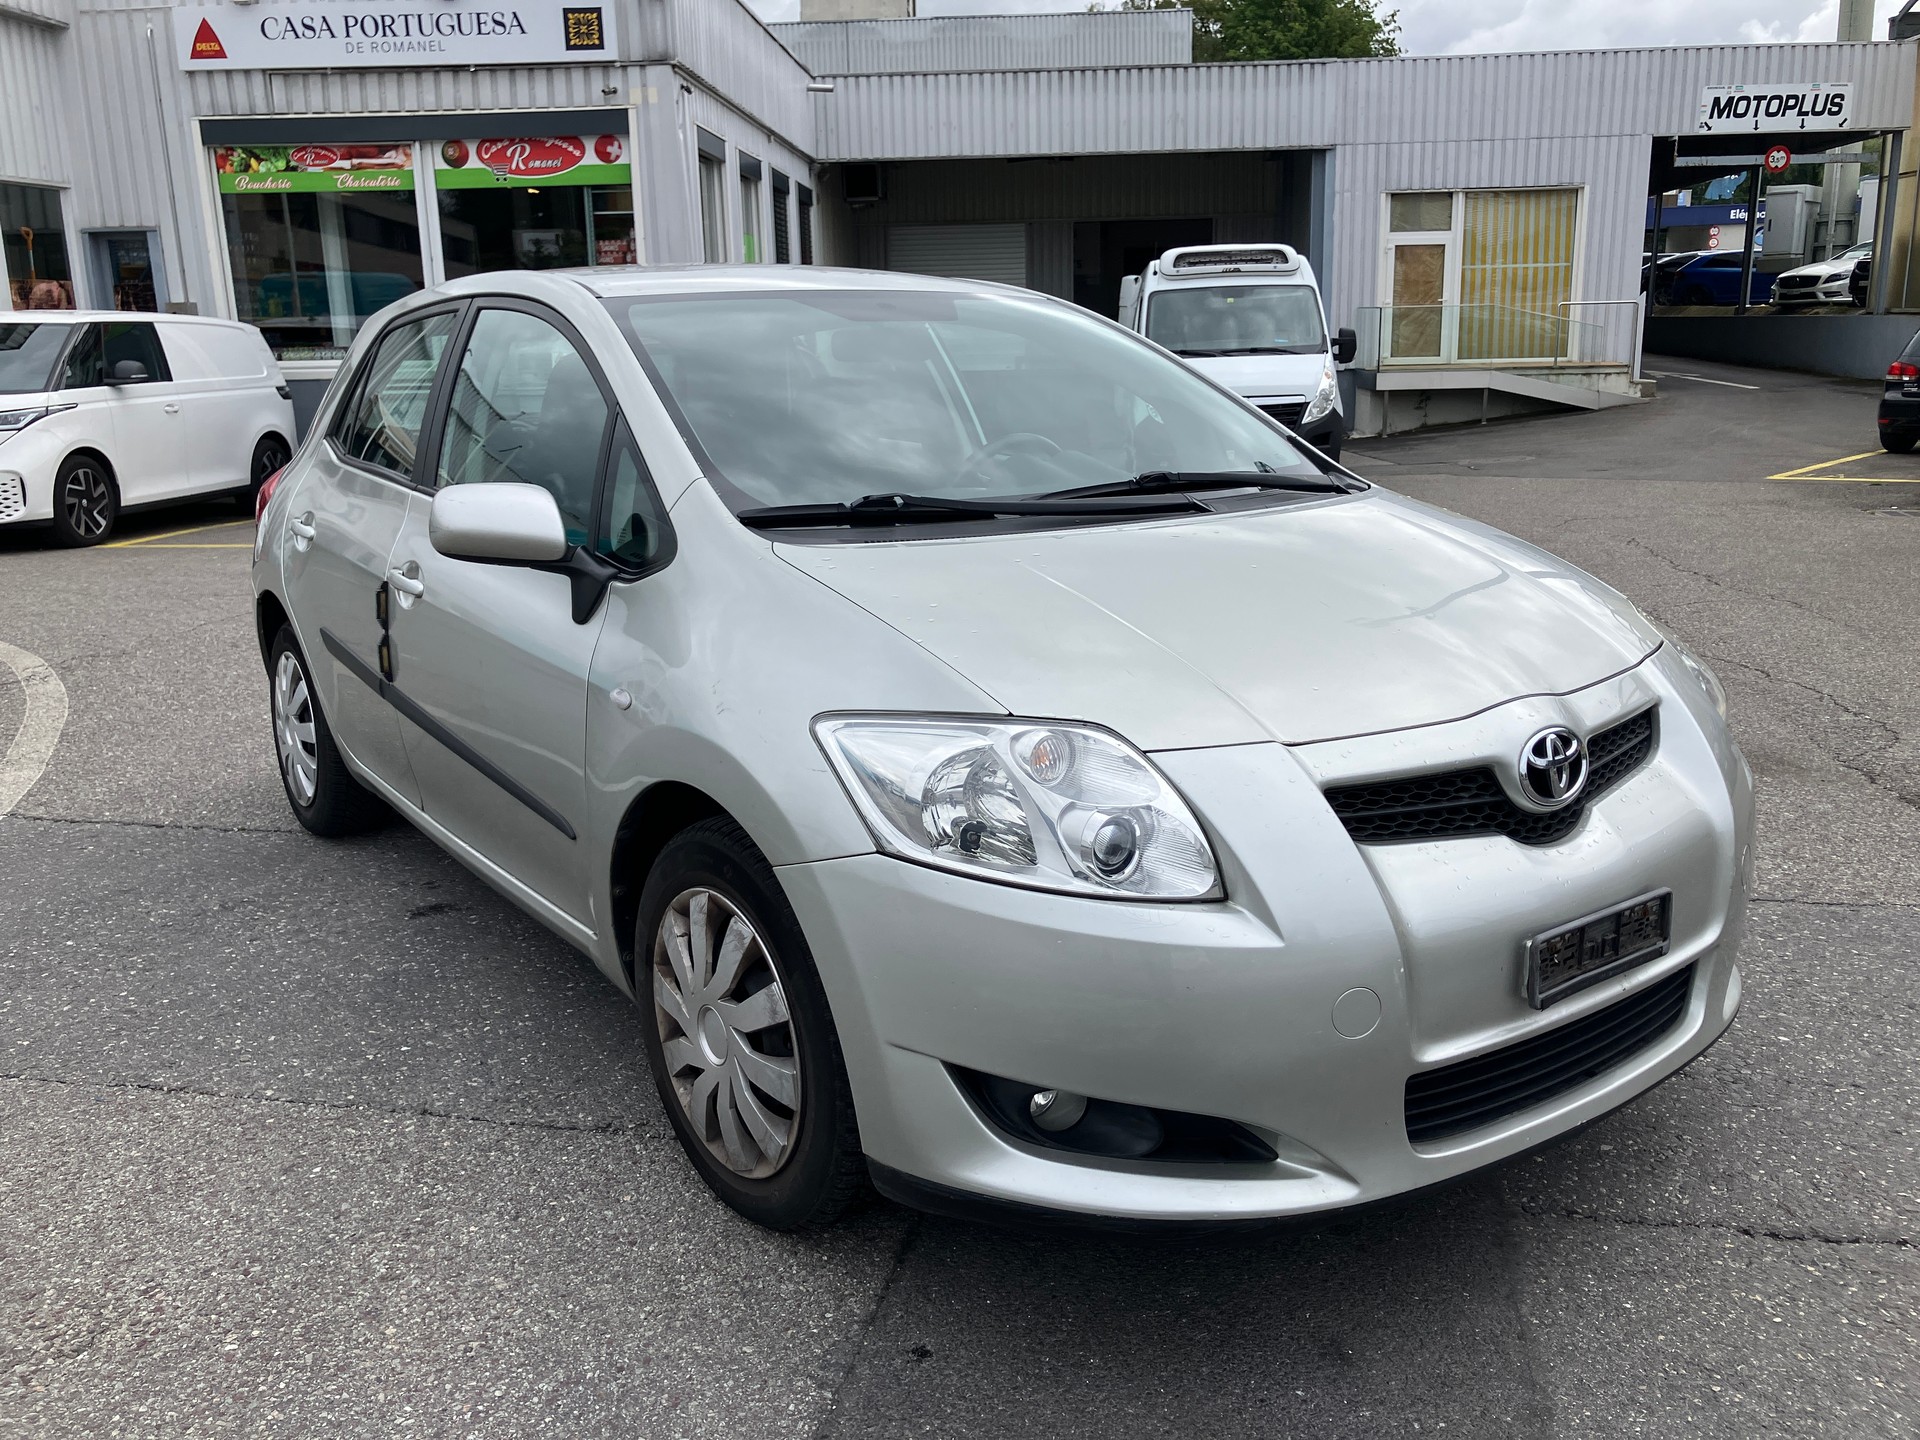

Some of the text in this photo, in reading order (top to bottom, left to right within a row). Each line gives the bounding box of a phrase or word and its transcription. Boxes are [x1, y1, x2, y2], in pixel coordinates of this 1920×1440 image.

[260, 11, 528, 40] CASA PORTUGUESA
[196, 42, 220, 51] DELTA
[345, 39, 446, 54] DE ROMANEL
[1708, 93, 1846, 120] MOTOPLUS
[506, 143, 563, 171] Romanel
[235, 175, 293, 191] Boucherie
[333, 173, 402, 189] Charcuterie
